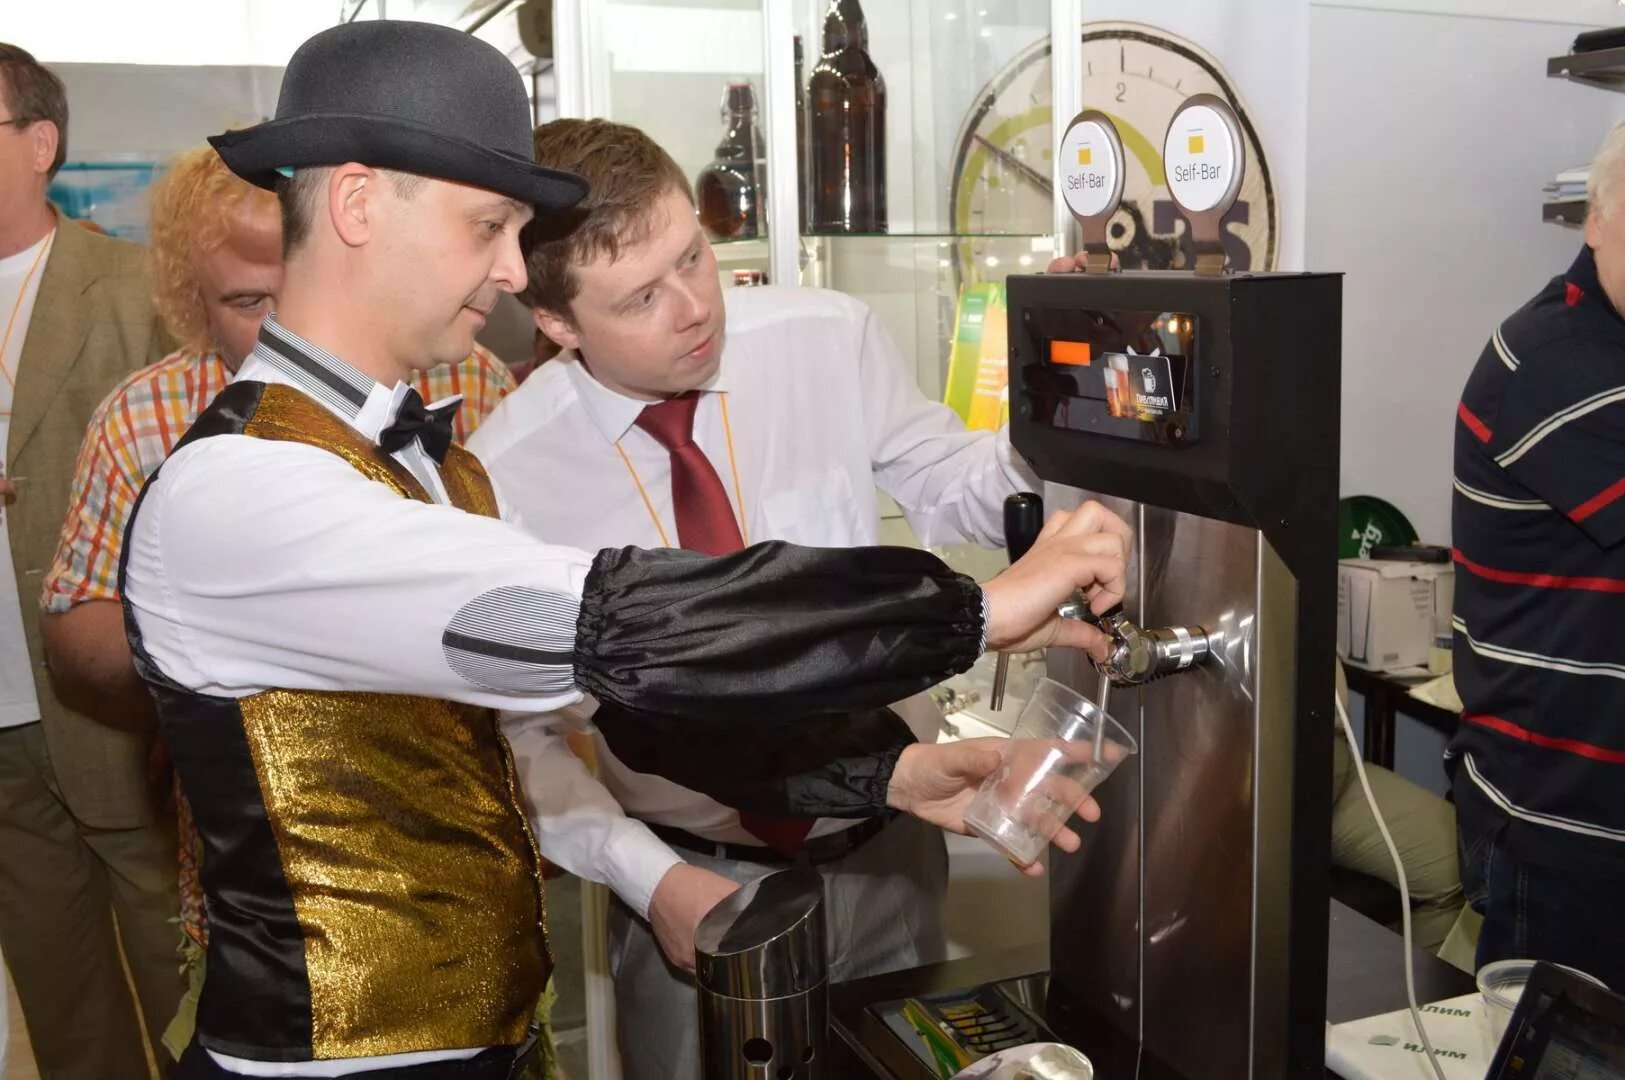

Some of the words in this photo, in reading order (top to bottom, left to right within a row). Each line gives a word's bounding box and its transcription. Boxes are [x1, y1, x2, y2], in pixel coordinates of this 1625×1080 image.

[1115, 82, 1127, 103] 2
[1067, 172, 1106, 191] Self-Bar
[1174, 162, 1222, 183] Self-Bar
